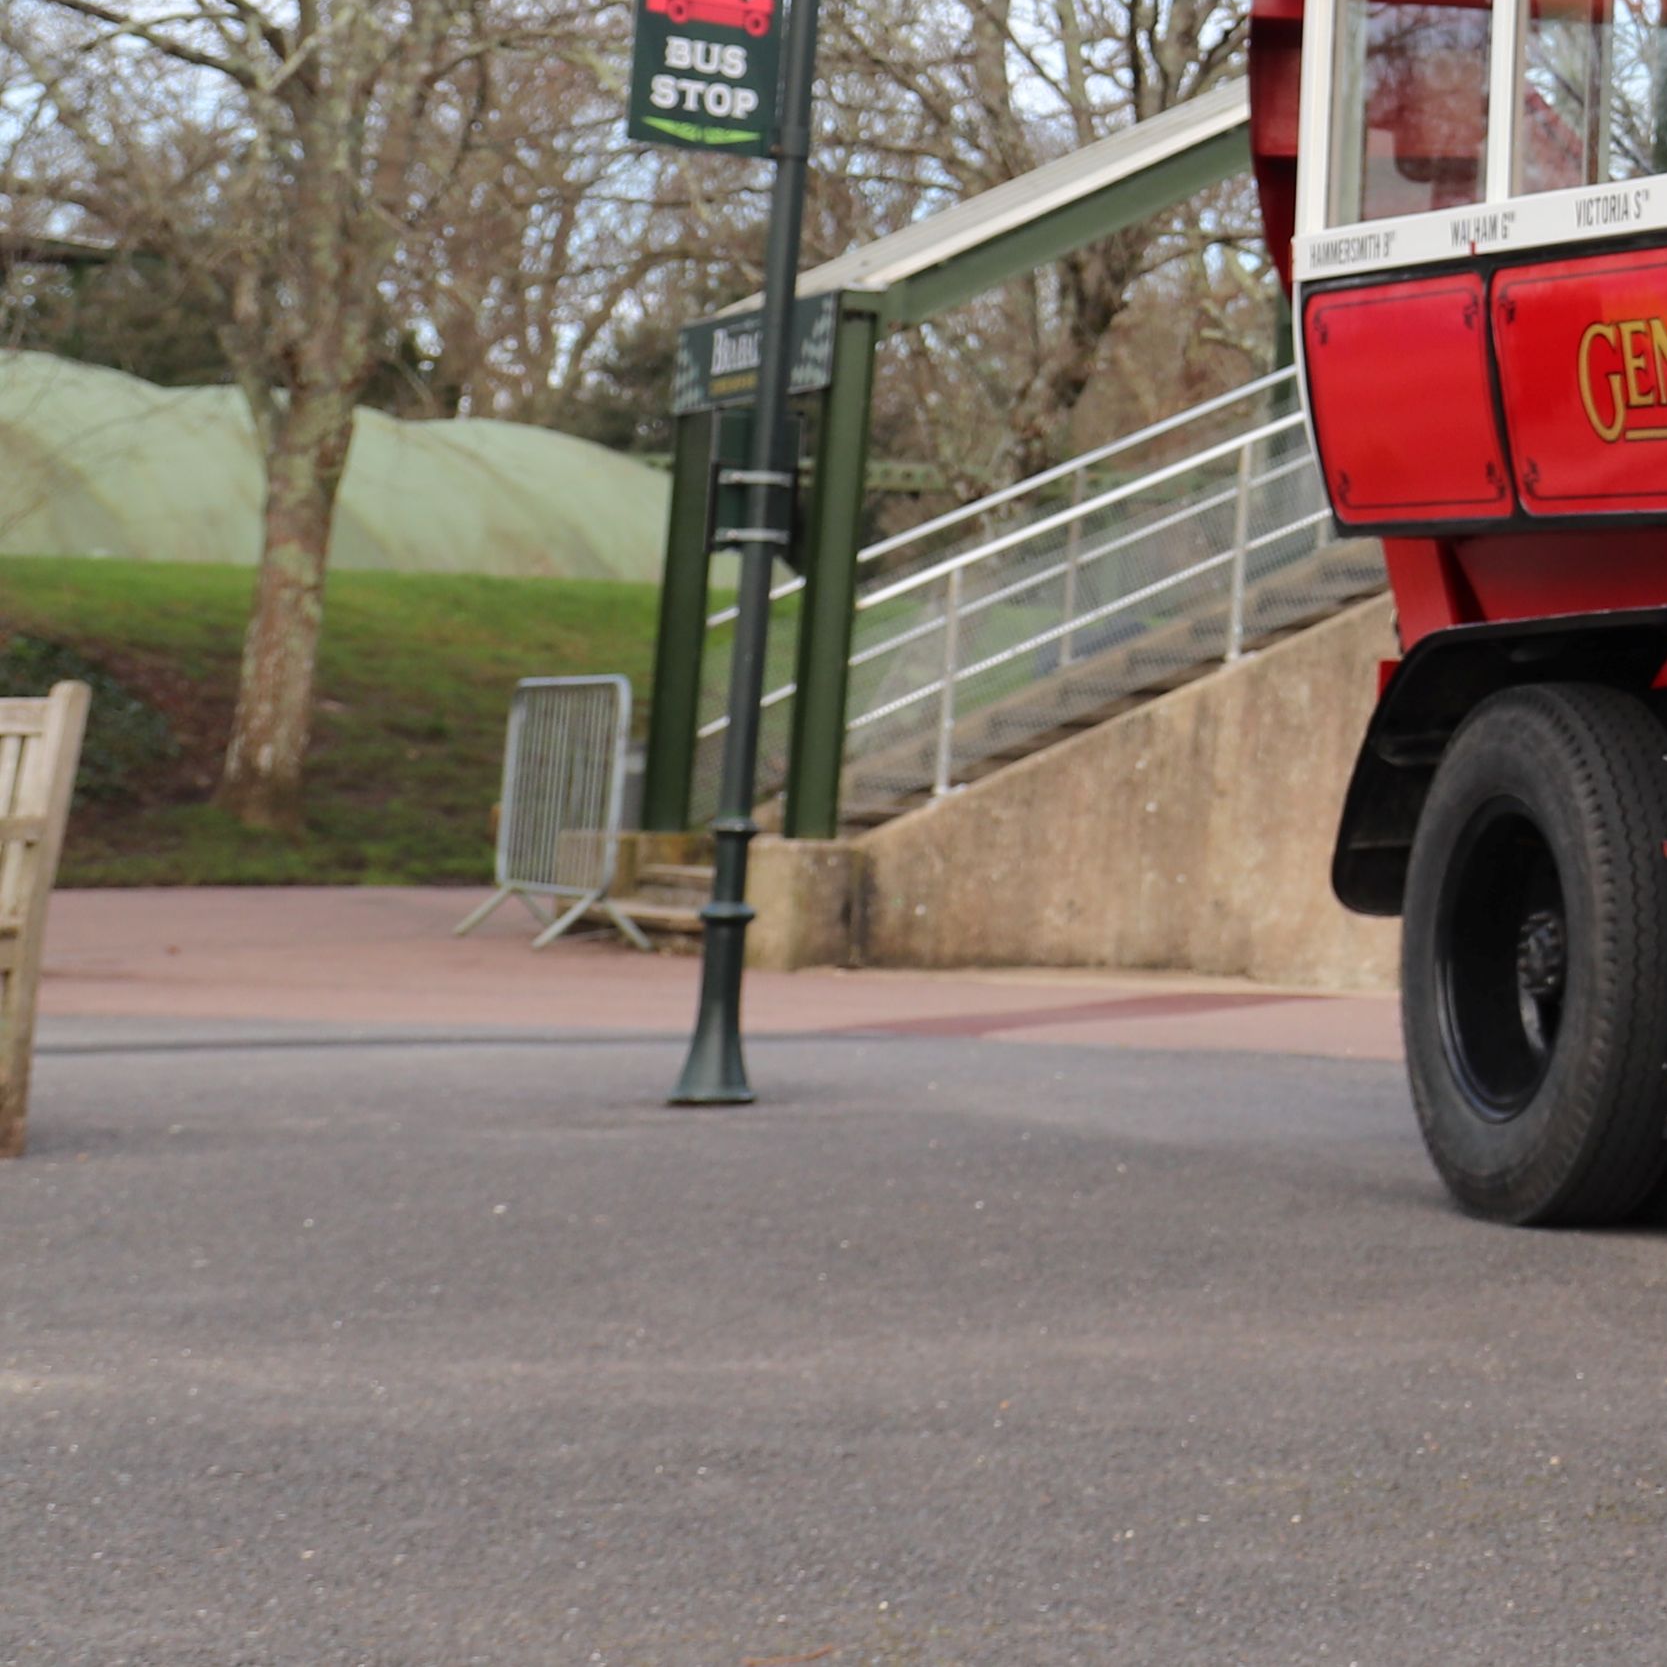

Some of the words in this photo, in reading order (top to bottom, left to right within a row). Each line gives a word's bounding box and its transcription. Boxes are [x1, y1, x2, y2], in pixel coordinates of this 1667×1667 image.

[665, 36, 748, 79] BUS
[650, 74, 760, 120] STOP
[1575, 192, 1628, 229] VICTORIA
[1449, 214, 1497, 247] WALHAM
[1309, 233, 1380, 270] HAMMERSMITH
